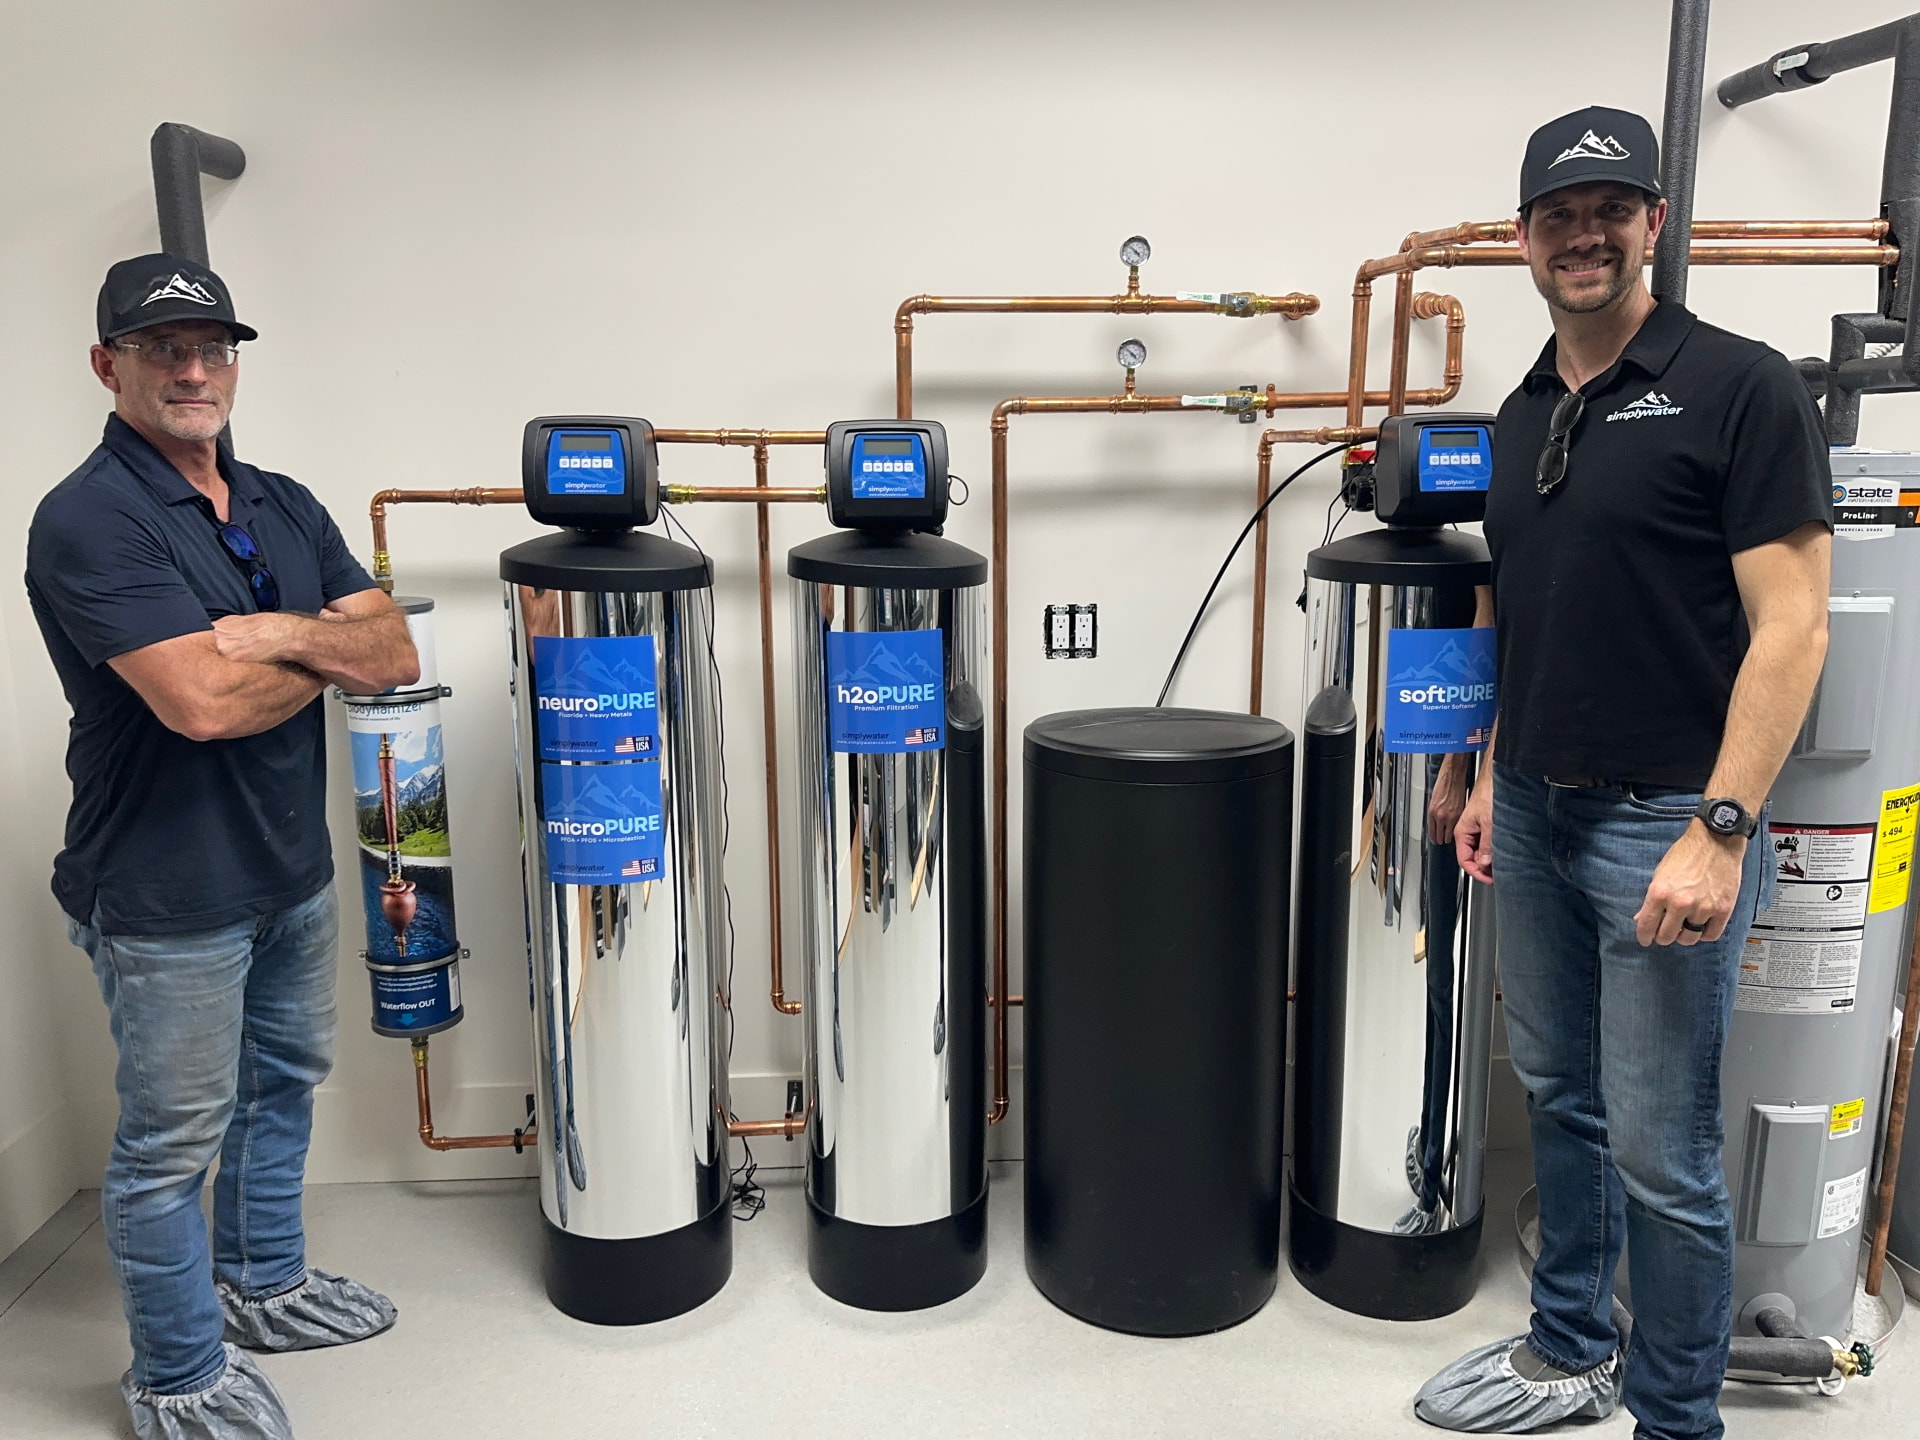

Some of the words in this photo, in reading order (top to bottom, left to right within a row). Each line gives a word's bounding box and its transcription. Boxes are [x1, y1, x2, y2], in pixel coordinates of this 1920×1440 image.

[1606, 407, 1683, 422] simplywater
[564, 481, 606, 490] simplywater
[1435, 478, 1475, 487] simplywater
[868, 485, 908, 494] simplywater
[1847, 487, 1893, 498] state
[837, 683, 935, 704] h2oPURE
[1399, 683, 1494, 704] softPURE
[539, 691, 656, 712] neuroPURE
[842, 732, 890, 741] simplywater
[923, 732, 937, 743] USA
[1399, 731, 1452, 740] simplywater
[550, 738, 599, 748] simplywater
[635, 741, 650, 751] USA
[547, 815, 660, 836] microPURE
[1888, 826, 1903, 836] 494
[603, 835, 646, 843] Microplastics
[558, 862, 606, 872] simplywater
[641, 863, 656, 874] USA
[380, 1001, 418, 1011] Waterflow
[418, 998, 436, 1009] OUT
